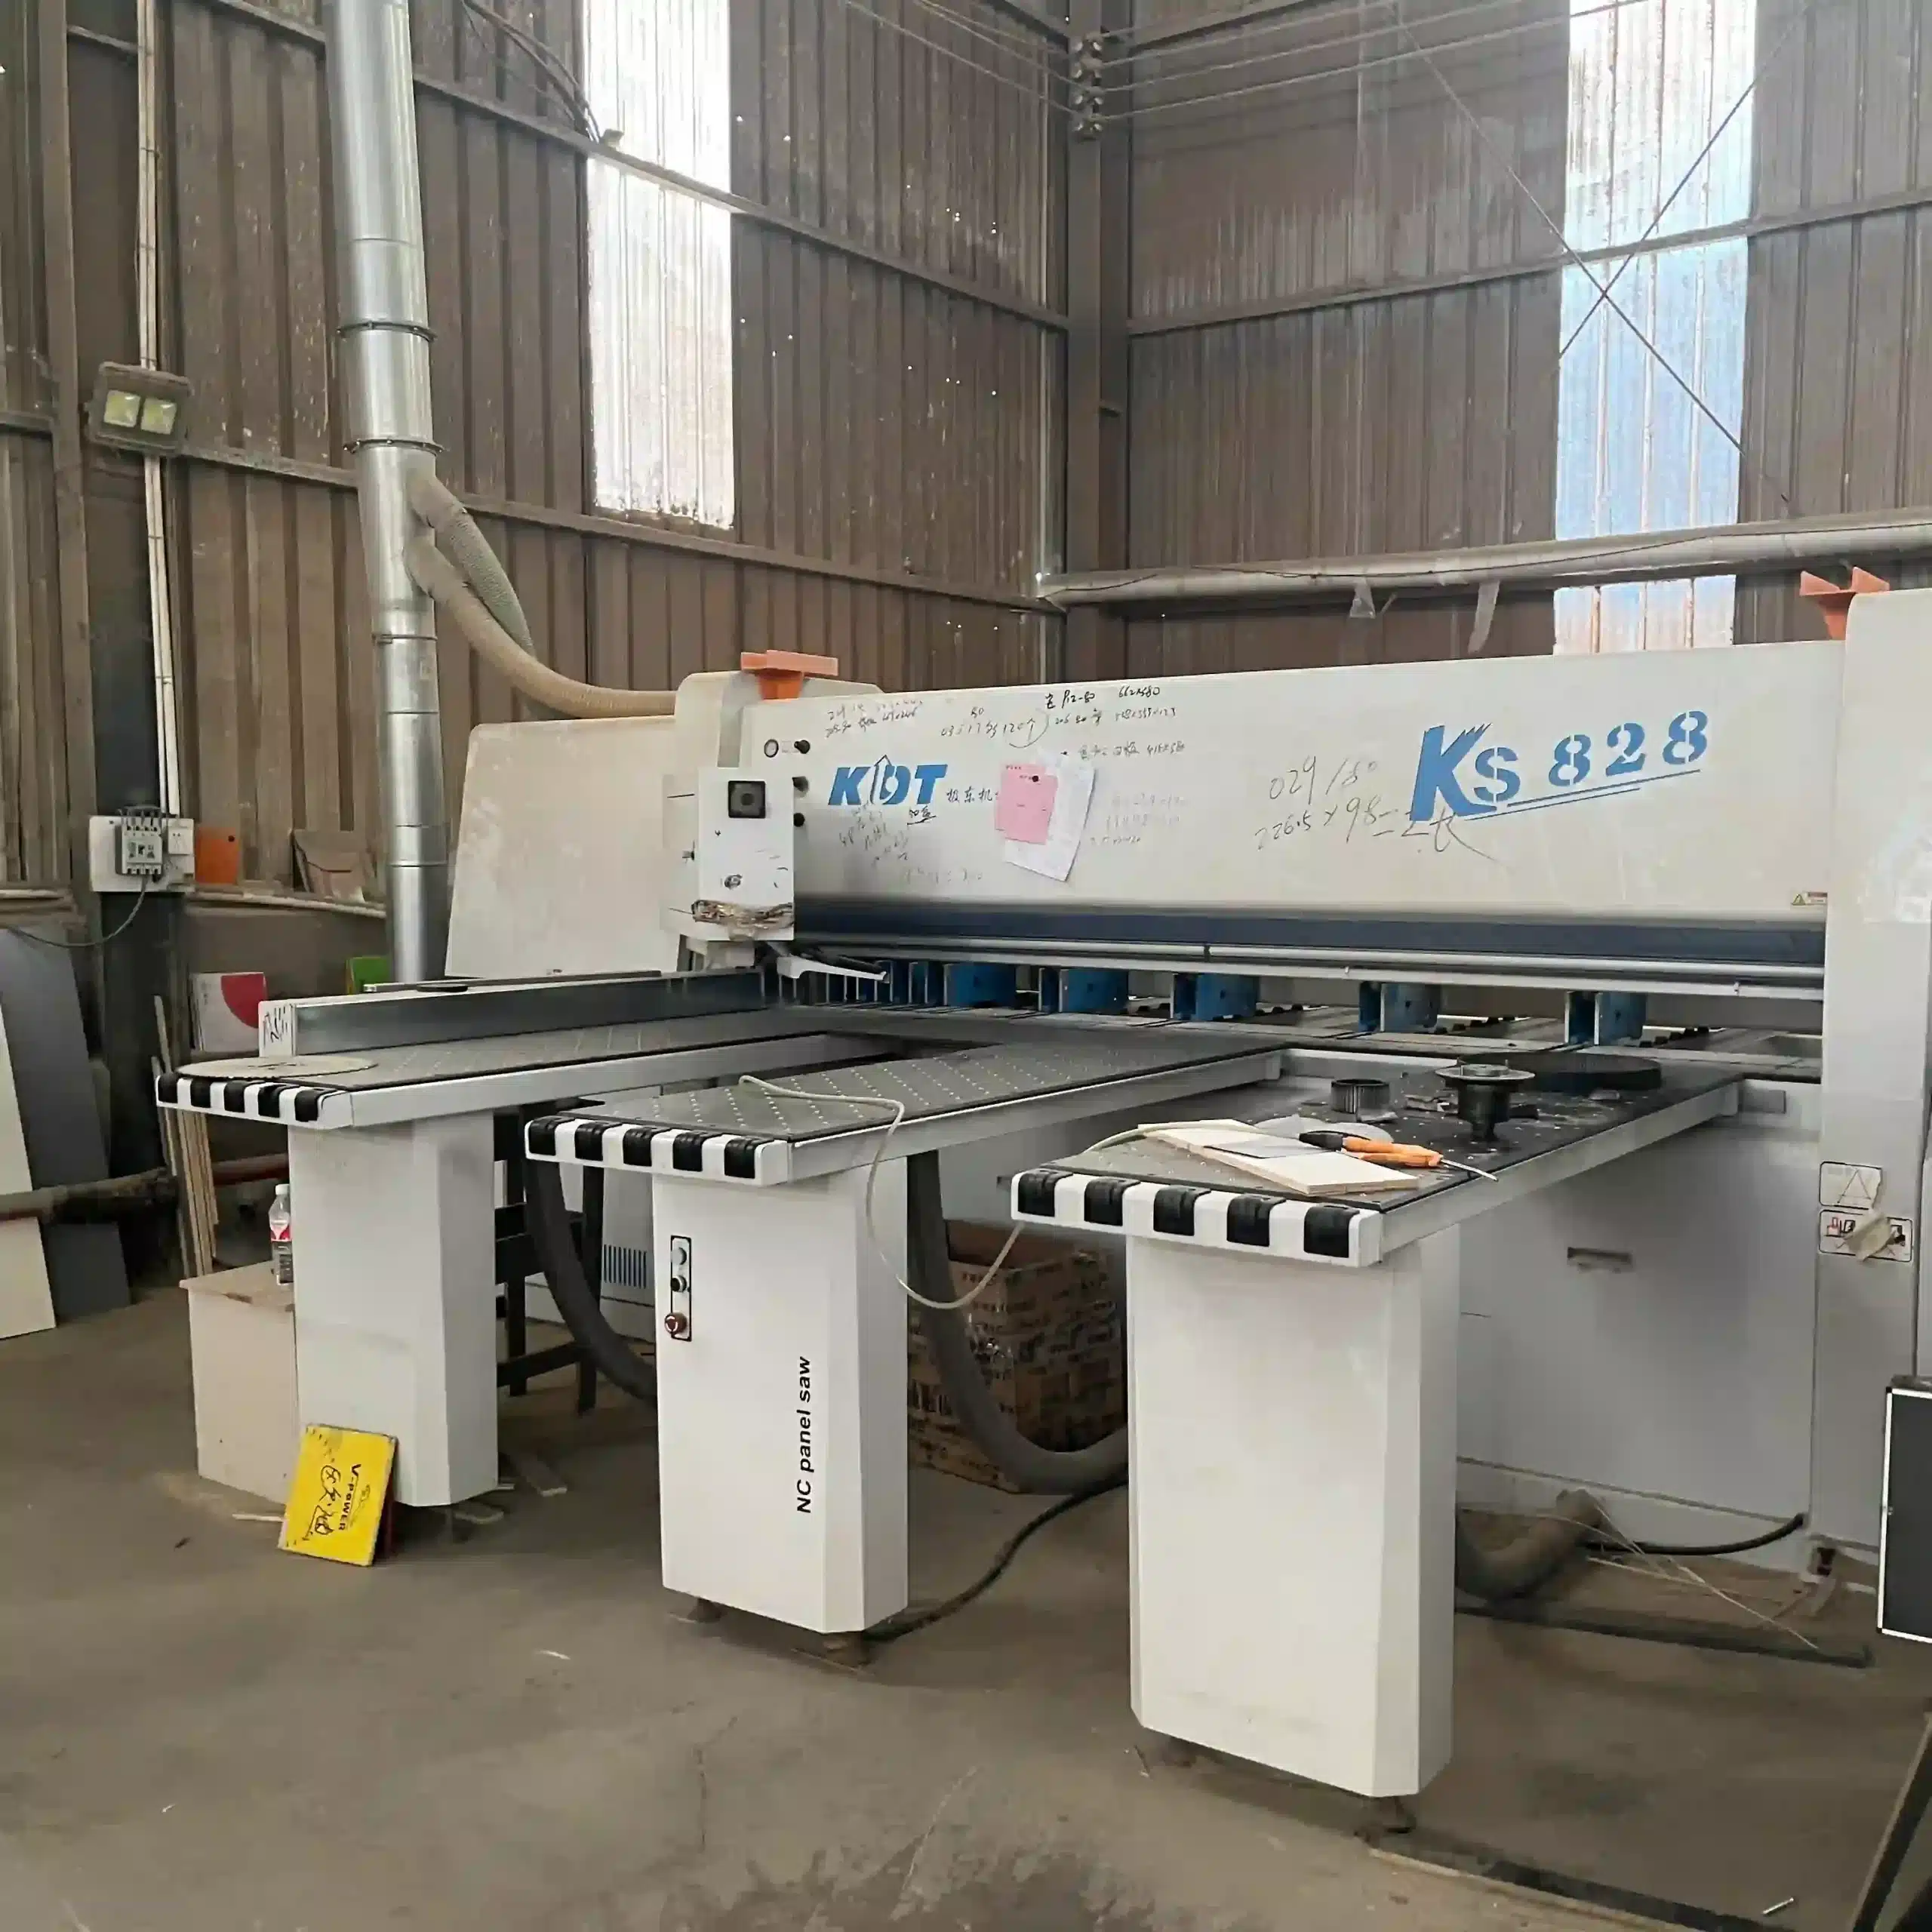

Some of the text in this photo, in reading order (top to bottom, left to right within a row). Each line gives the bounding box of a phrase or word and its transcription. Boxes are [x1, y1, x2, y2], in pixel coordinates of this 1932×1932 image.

[1548, 710, 1709, 786] 828
[827, 763, 948, 806] KDT
[946, 786, 999, 804] 极东机
[796, 1356, 814, 1513] NC panel saw
